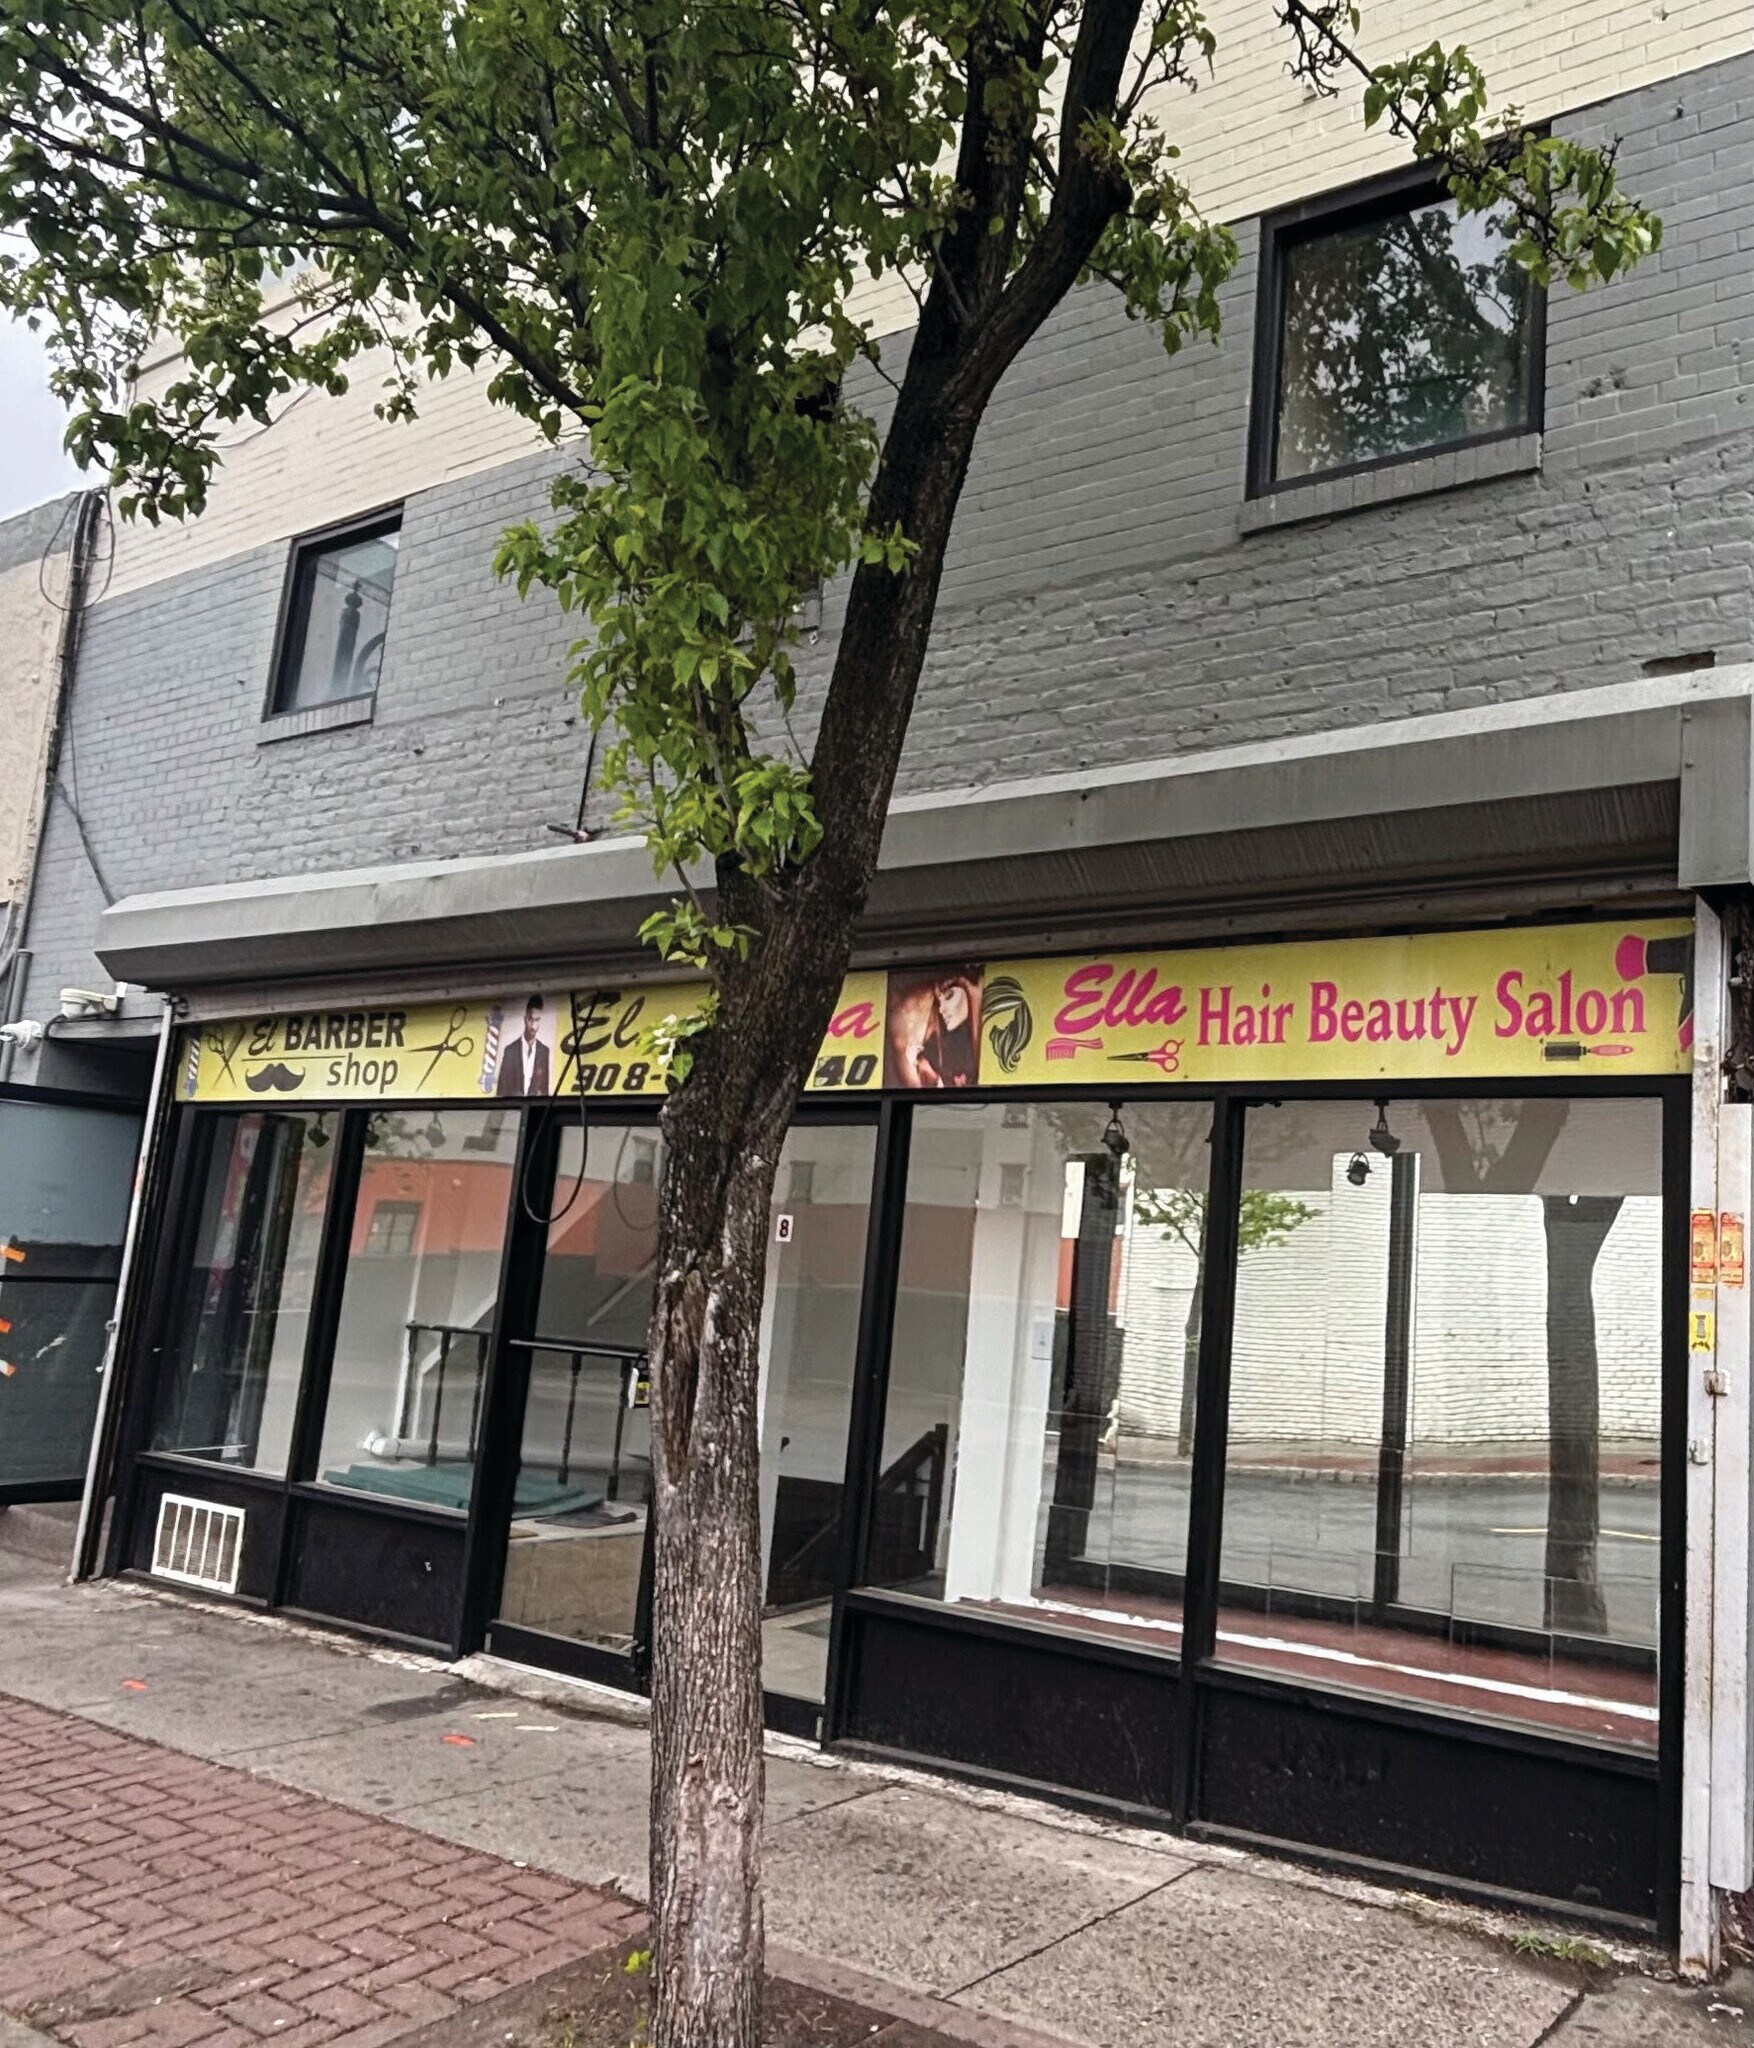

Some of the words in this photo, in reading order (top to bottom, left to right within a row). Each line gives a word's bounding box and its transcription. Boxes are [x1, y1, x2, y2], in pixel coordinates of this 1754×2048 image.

[1054, 963, 1188, 1035] Ella
[1197, 983, 1294, 1046] Hair
[1308, 981, 1477, 1056] Beauty
[1495, 968, 1646, 1038] Salon
[247, 1019, 280, 1056] El
[283, 1011, 408, 1051] BARBER
[326, 1052, 399, 1094] shop
